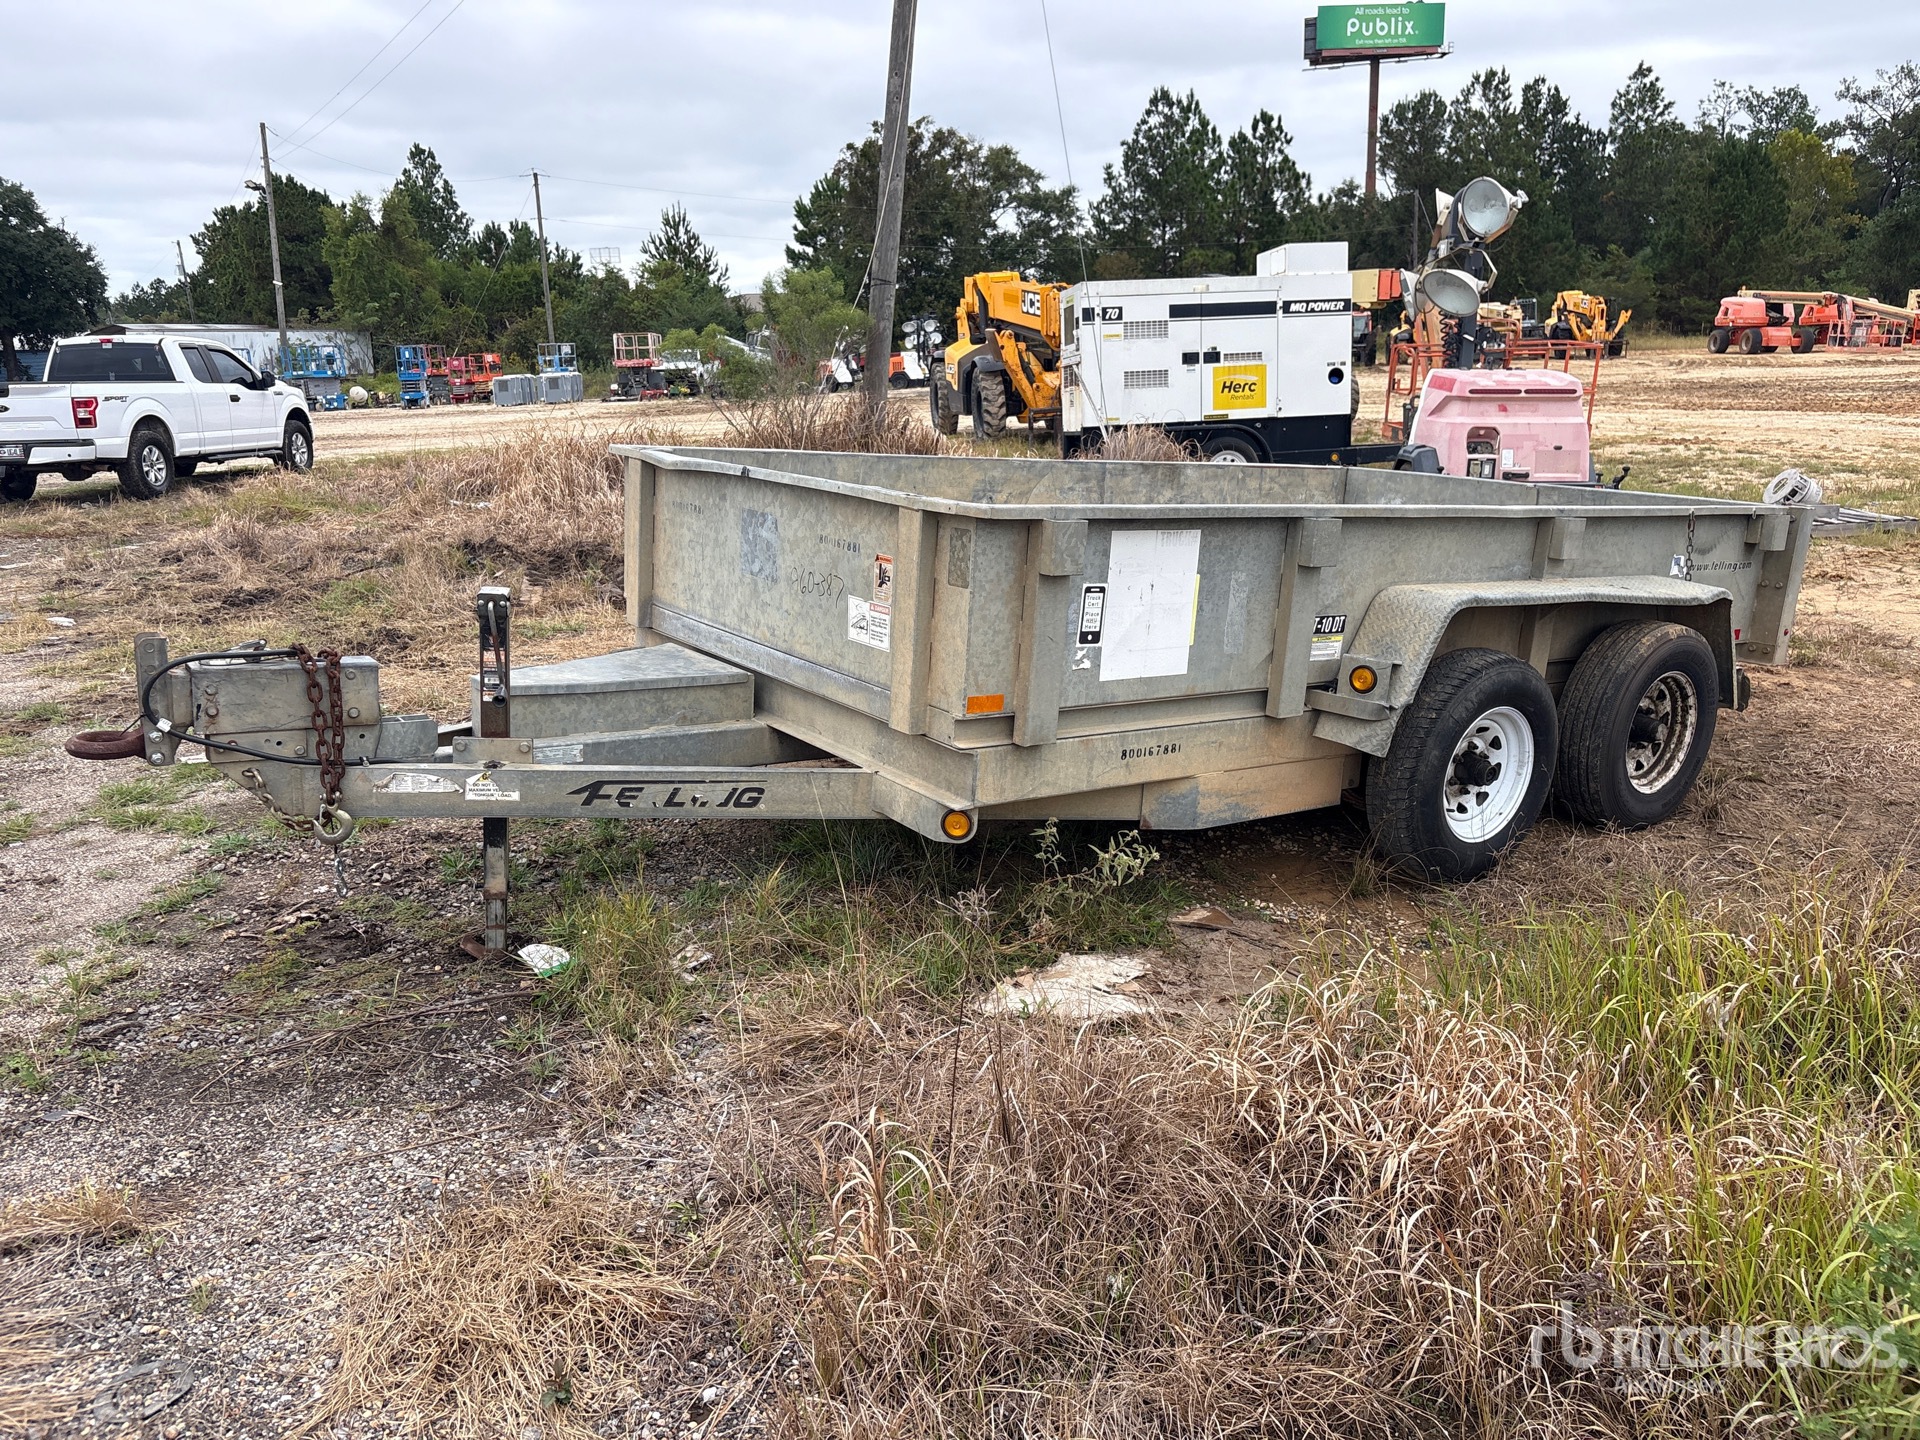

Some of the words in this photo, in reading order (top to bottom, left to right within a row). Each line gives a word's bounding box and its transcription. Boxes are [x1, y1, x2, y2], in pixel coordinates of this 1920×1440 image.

[1355, 7, 1364, 15] All
[1365, 6, 1384, 15] roads
[1385, 6, 1401, 14] lead
[1346, 17, 1415, 37] Publix
[1021, 291, 1041, 316] JCB
[1289, 301, 1307, 312] MQ
[1307, 301, 1345, 312] POWER
[1105, 308, 1119, 319] 70
[1220, 380, 1257, 394] Herc
[102, 395, 130, 403] SPORT
[1229, 393, 1254, 401] Rentals
[1331, 616, 1346, 633] DT
[1120, 743, 1182, 761] 800167881
